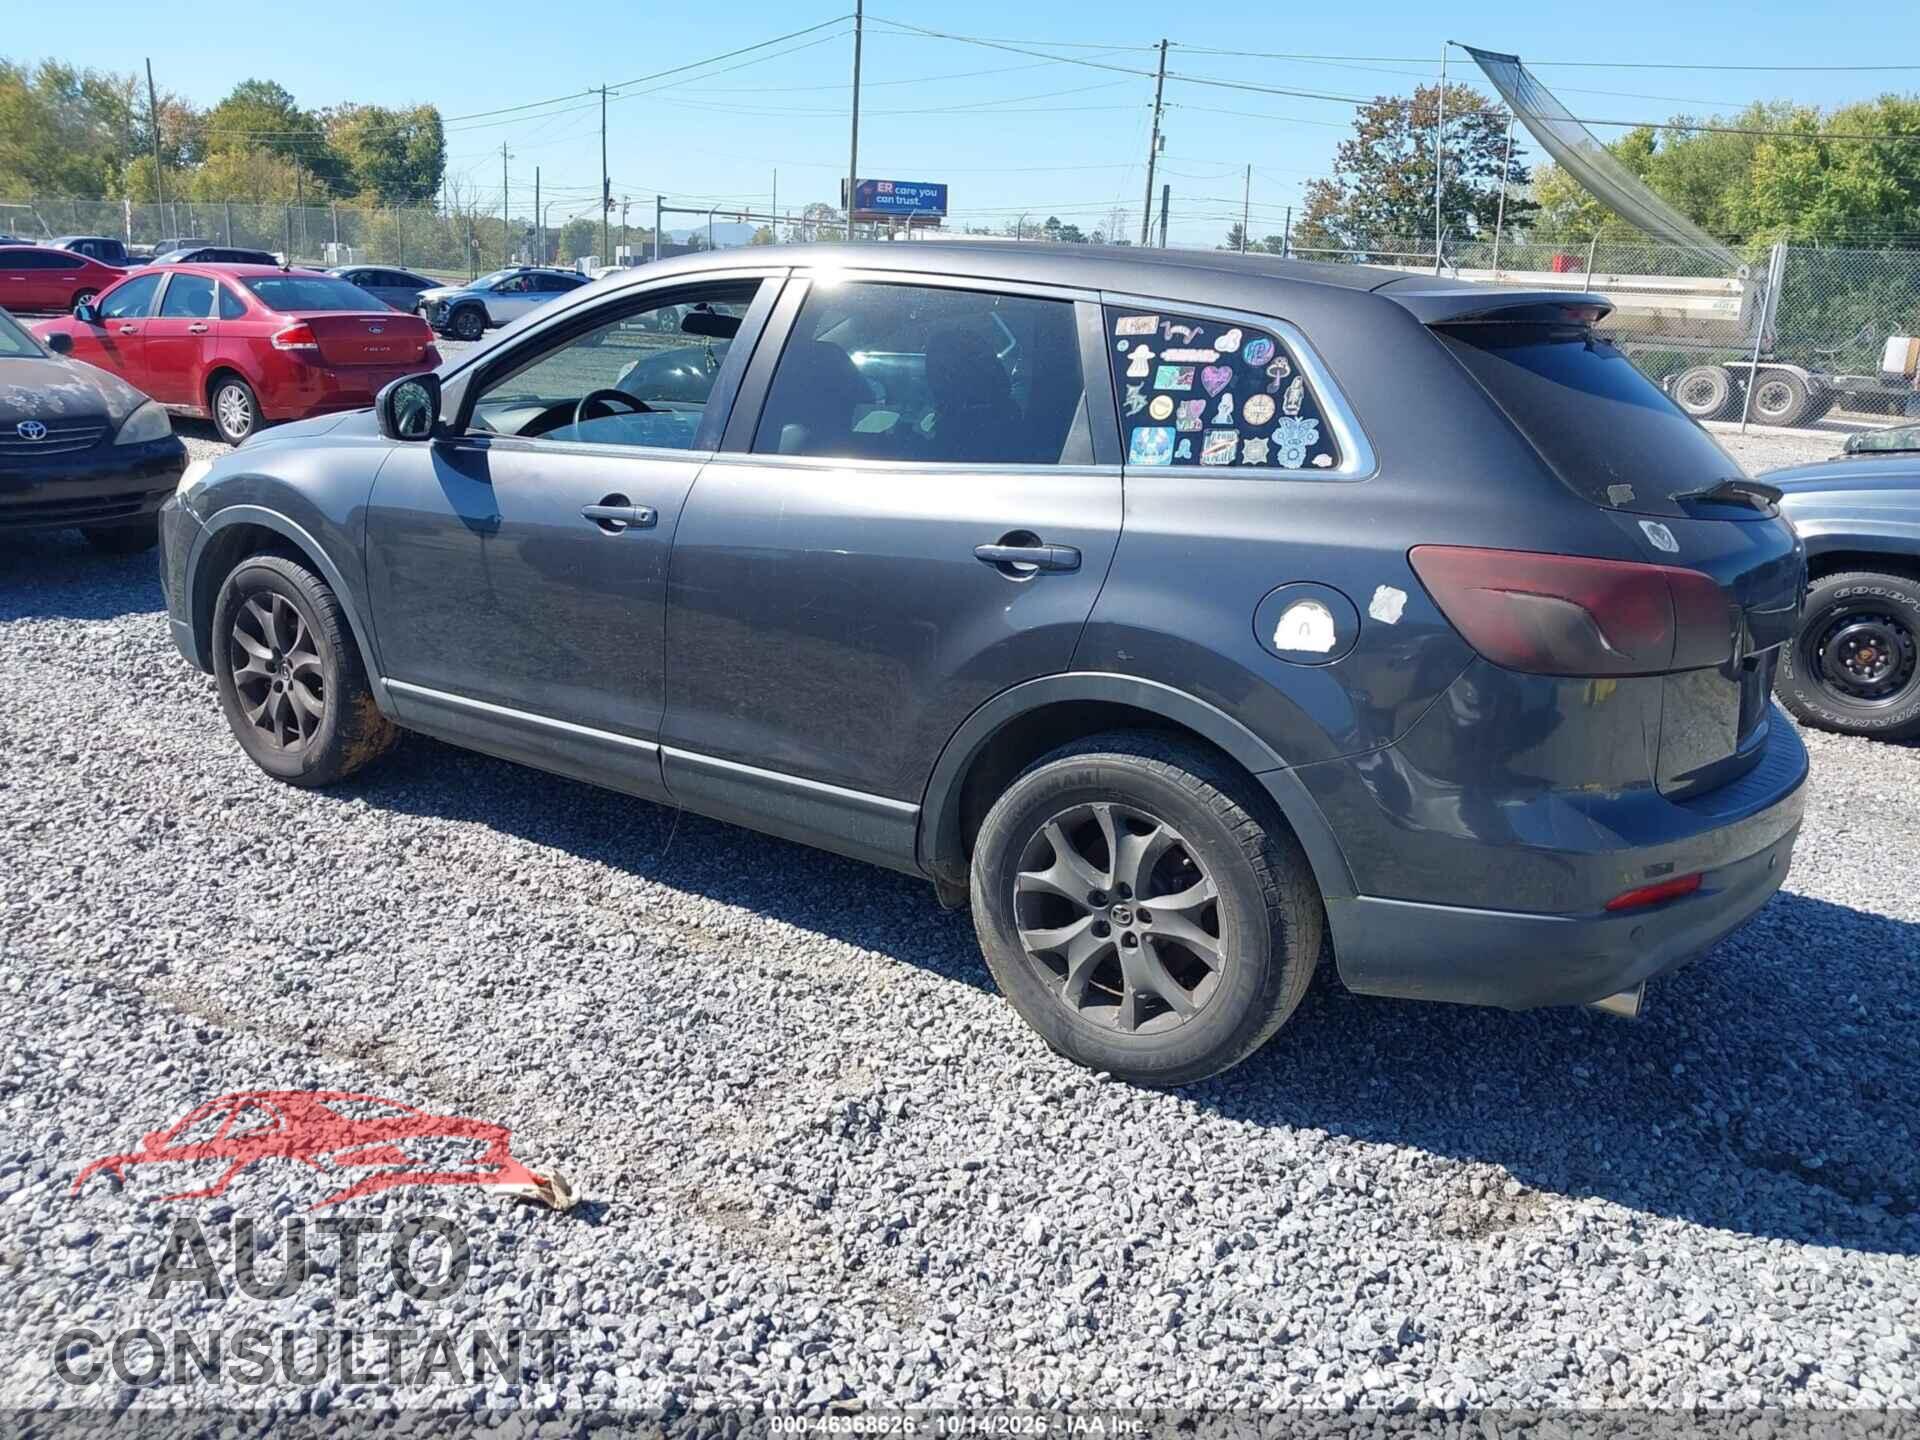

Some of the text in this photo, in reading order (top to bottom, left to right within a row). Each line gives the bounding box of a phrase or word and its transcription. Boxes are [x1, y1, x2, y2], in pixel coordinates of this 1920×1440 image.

[877, 182, 938, 198] ER care you
[876, 195, 921, 206] can trust.
